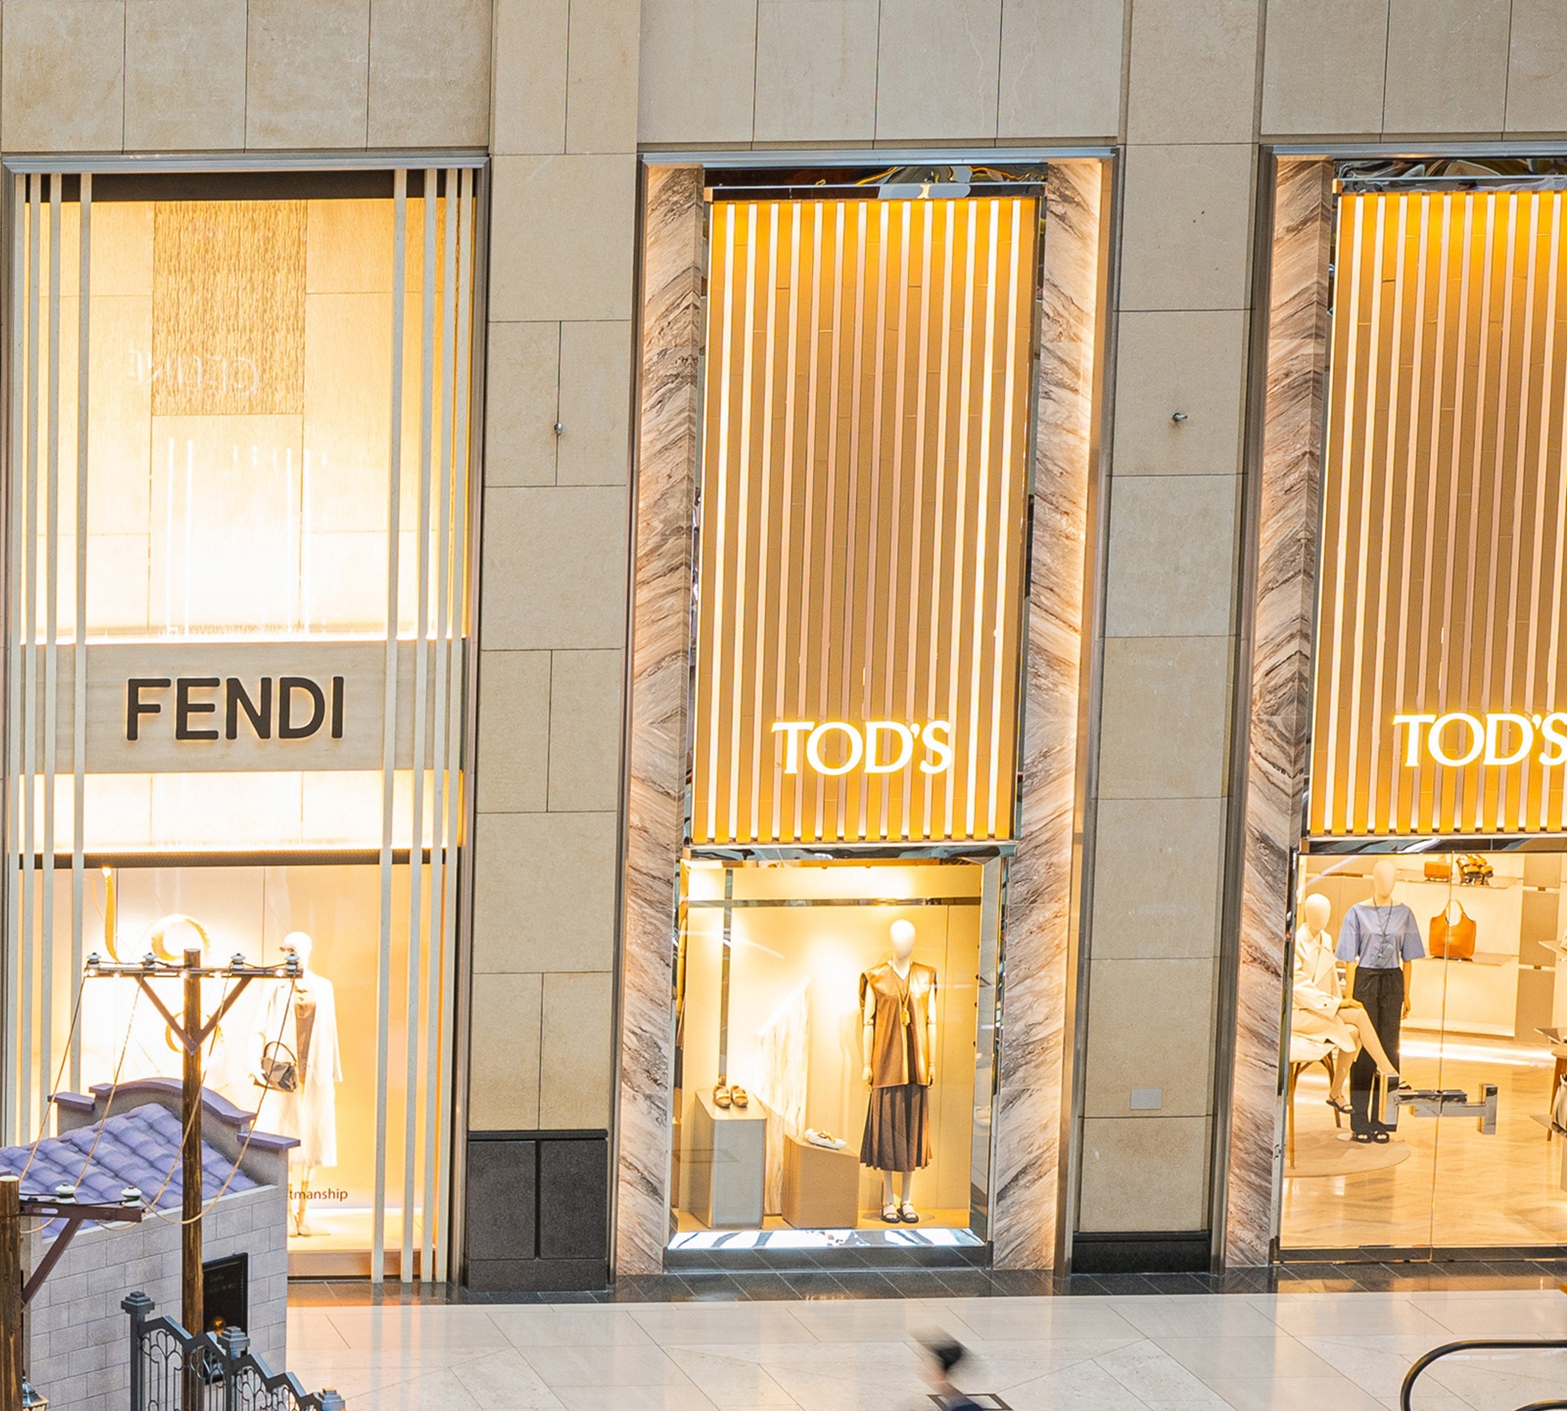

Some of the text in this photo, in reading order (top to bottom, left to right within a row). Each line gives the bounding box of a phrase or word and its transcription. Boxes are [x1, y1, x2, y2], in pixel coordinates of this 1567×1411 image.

[127, 676, 344, 741] FENDI
[771, 720, 953, 776] TOD'S
[1392, 712, 1567, 767] TOD'S
[289, 1188, 348, 1202] tmanship
